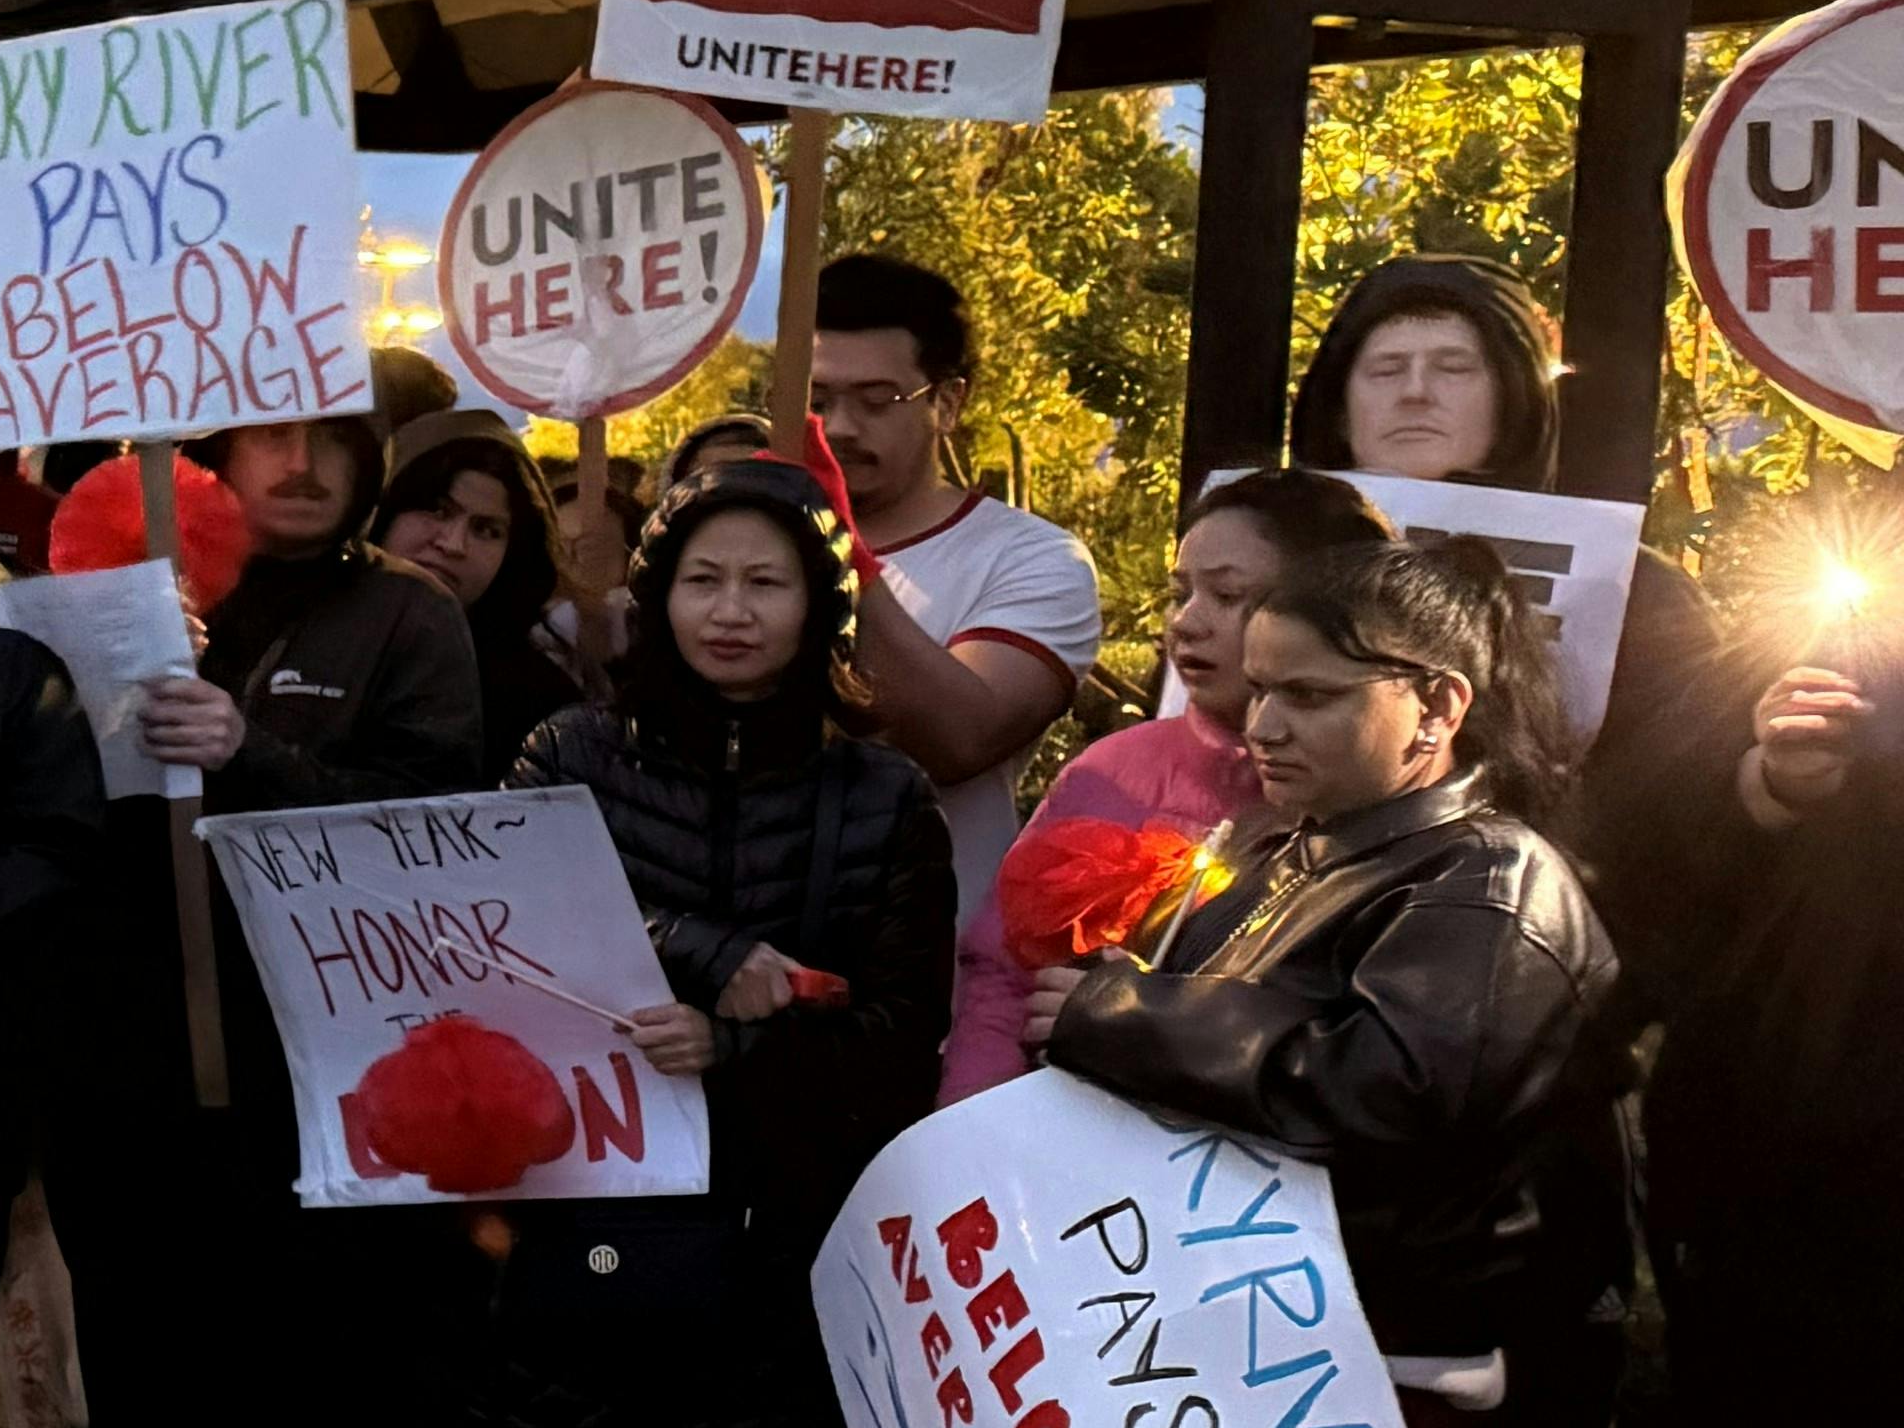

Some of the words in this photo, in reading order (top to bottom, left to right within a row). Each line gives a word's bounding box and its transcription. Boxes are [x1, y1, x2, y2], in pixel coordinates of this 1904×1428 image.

[676, 34, 956, 94] UNITEHERE!
[28, 134, 229, 276] PAYS
[470, 152, 726, 266] UNITE
[1747, 118, 1904, 209] UN
[1, 225, 307, 362] BELOW
[473, 230, 719, 346] HERE!
[1746, 226, 1904, 312] HE
[222, 817, 342, 894] NEW
[291, 898, 557, 1018] HONOR
